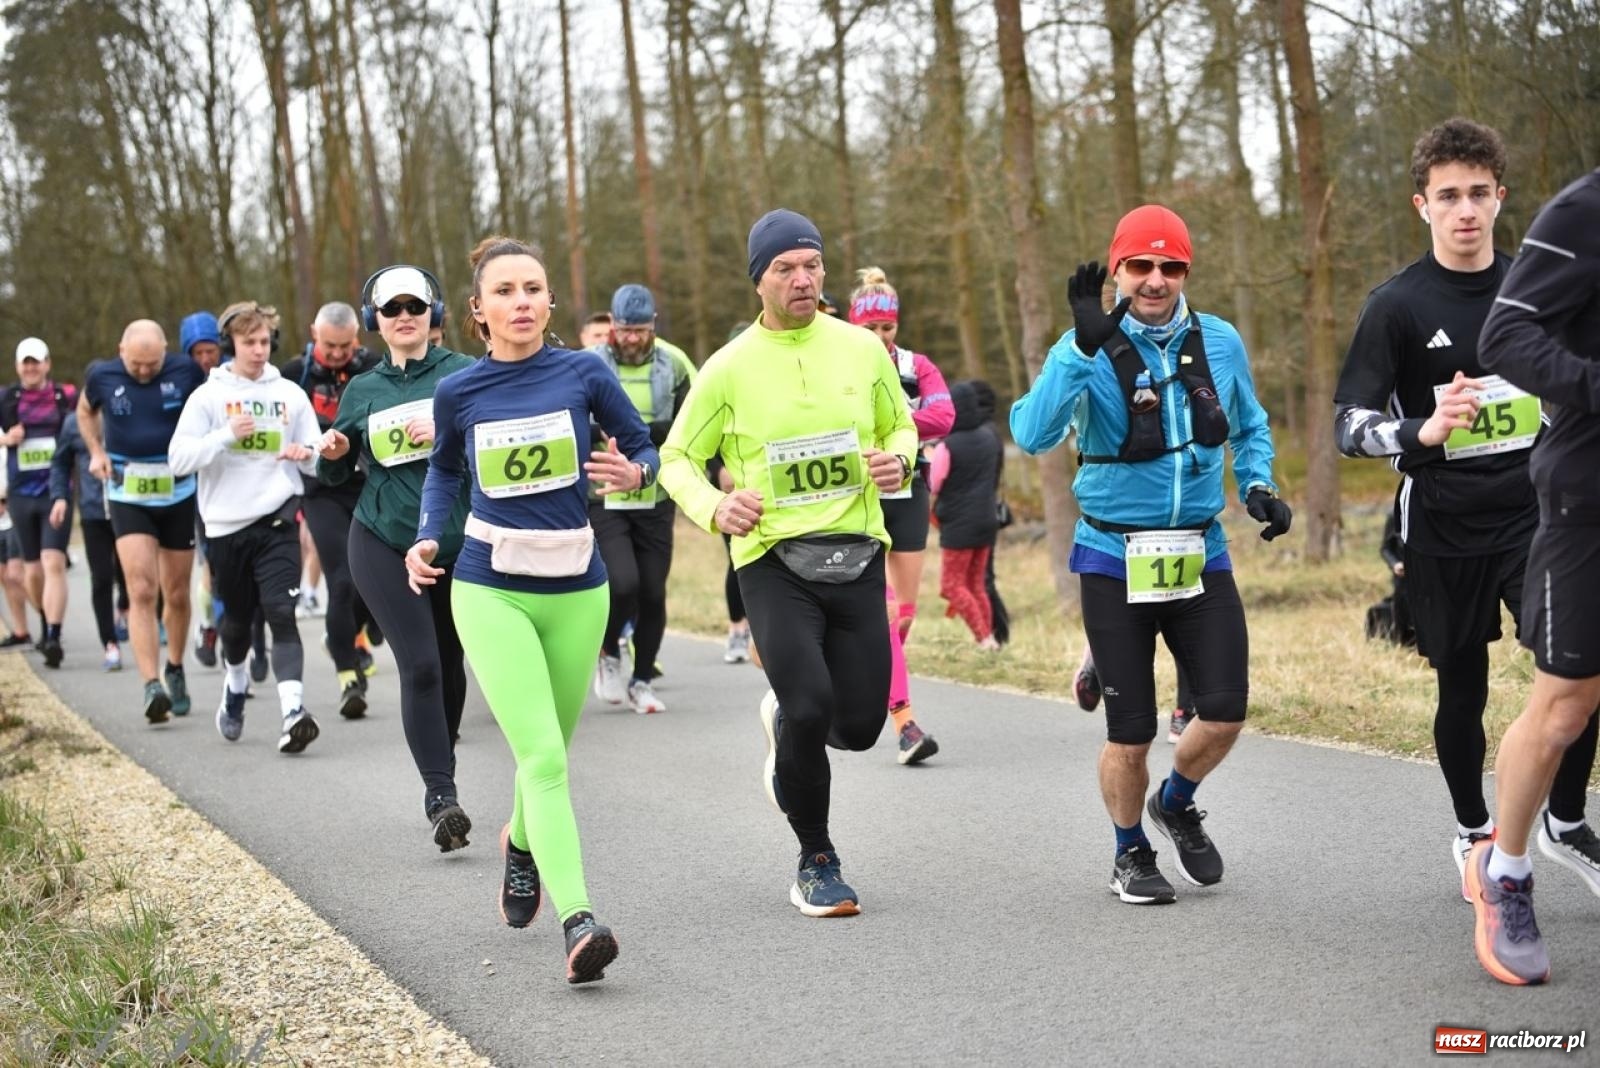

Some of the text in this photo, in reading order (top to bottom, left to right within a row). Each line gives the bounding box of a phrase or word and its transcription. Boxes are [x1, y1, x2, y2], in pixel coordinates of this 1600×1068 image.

[1470, 402, 1516, 439] 45
[242, 432, 267, 450] 85
[25, 450, 54, 464] 101
[504, 445, 552, 481] 62
[136, 478, 161, 494] 81
[785, 456, 849, 493] 105
[1150, 557, 1185, 588] 11
